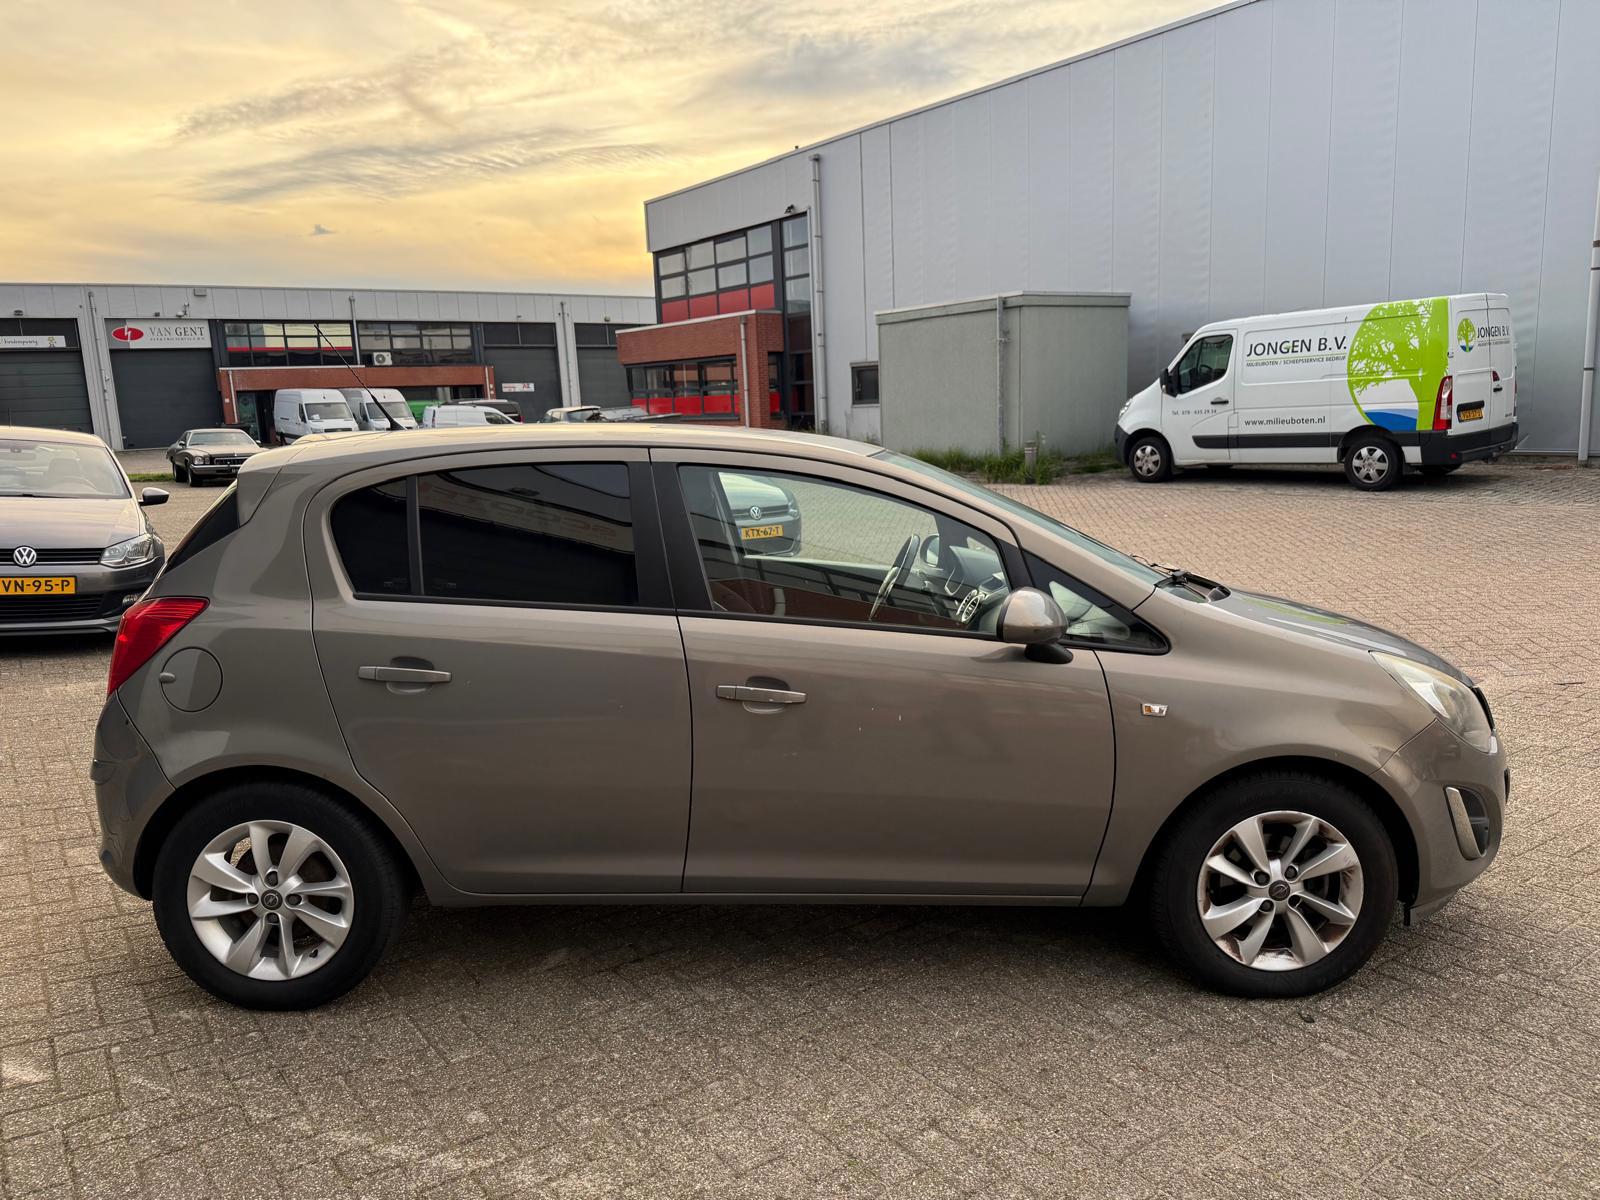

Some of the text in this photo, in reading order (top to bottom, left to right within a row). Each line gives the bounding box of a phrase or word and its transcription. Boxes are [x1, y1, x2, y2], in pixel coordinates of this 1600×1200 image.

[149, 326, 205, 337] VAN GENT
[1477, 326, 1501, 338] JONGEN
[1246, 338, 1312, 357] JONGEN
[1244, 416, 1326, 426] www.milieuboten.nl
[745, 526, 780, 538] KTX-67-T
[2, 579, 71, 593] VN-95-P
